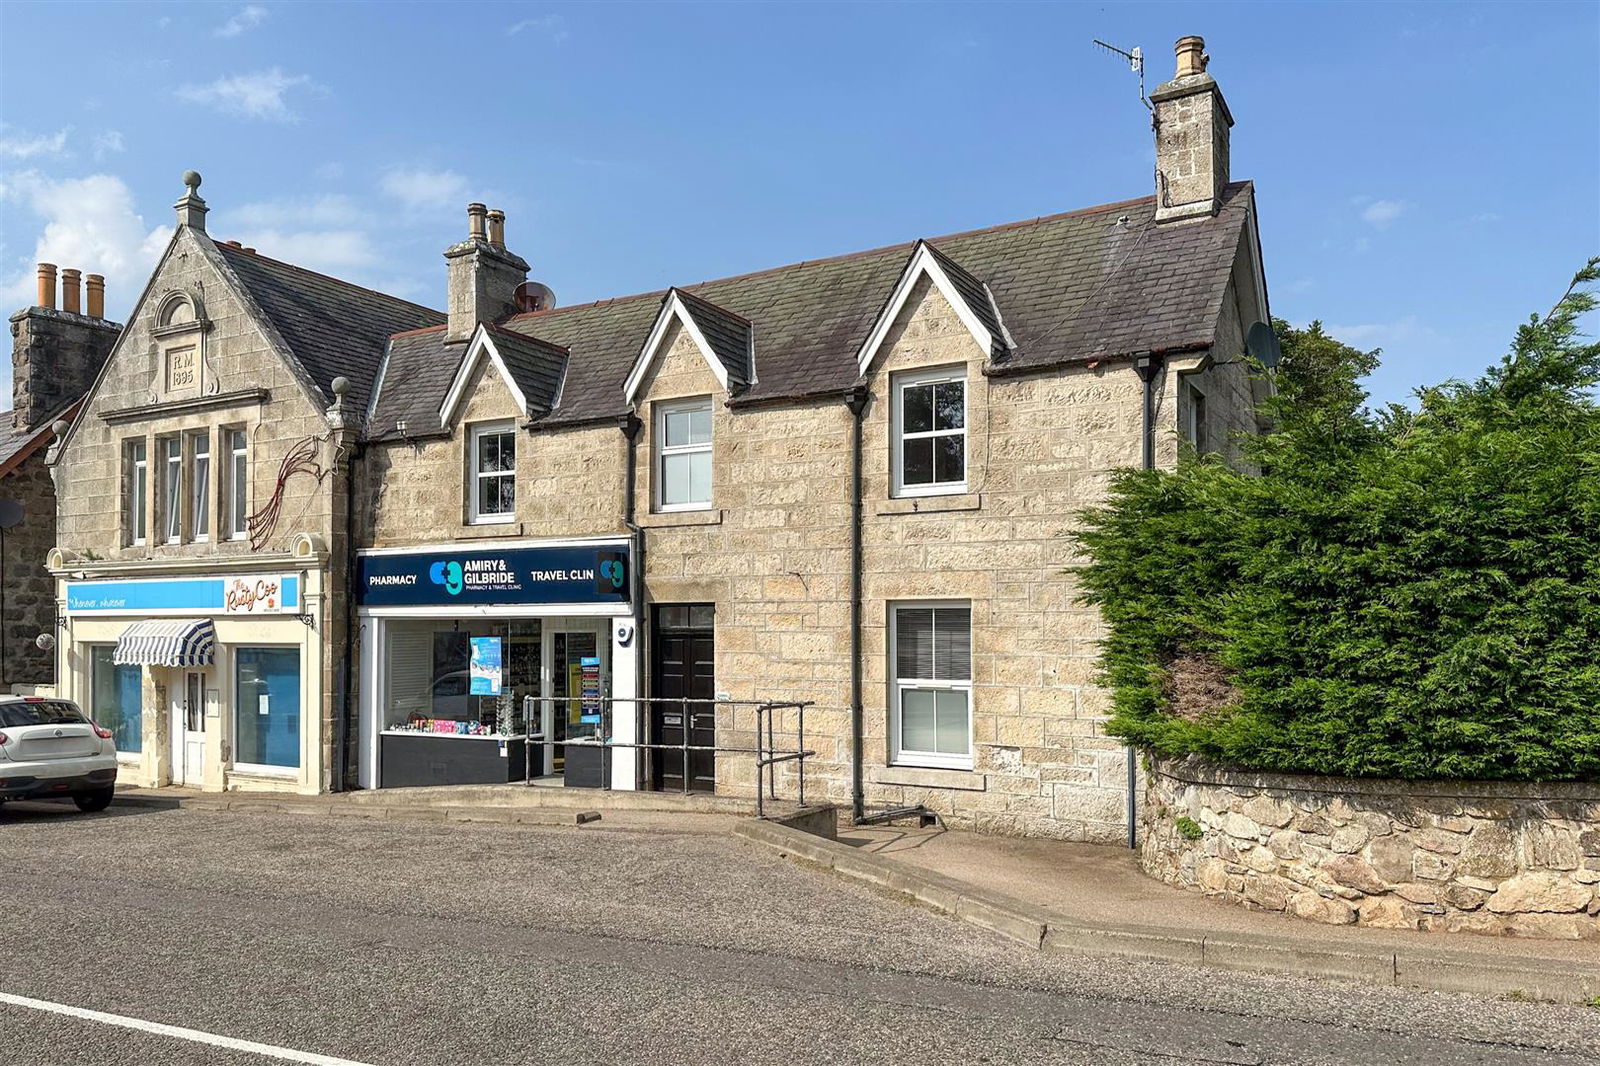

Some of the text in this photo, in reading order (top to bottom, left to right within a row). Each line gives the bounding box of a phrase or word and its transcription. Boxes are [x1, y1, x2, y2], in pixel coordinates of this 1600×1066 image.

[369, 574, 417, 586] PHARMACY
[464, 572, 515, 584] GILBRIDE
[531, 569, 594, 581] TRAVEL CLIN
[226, 586, 256, 612] Rusty
